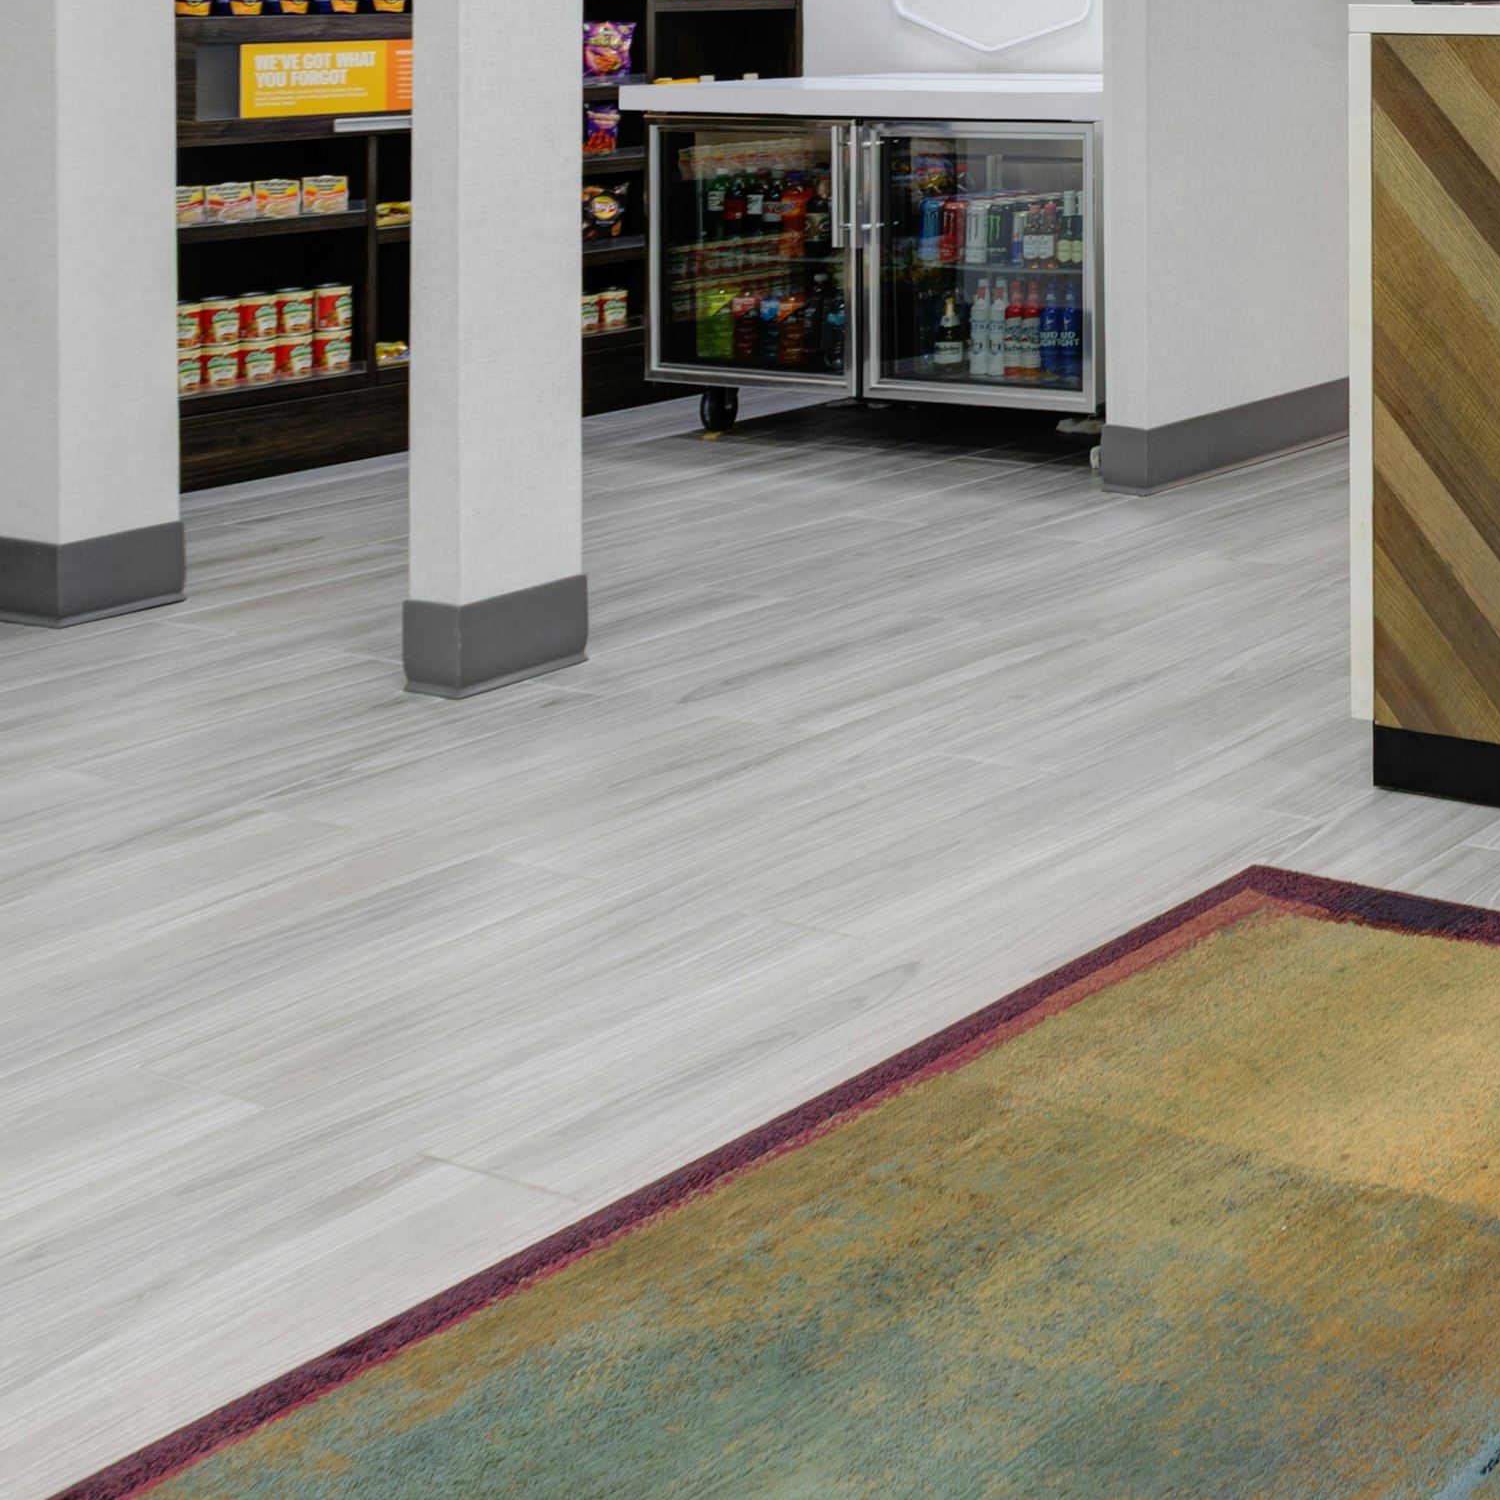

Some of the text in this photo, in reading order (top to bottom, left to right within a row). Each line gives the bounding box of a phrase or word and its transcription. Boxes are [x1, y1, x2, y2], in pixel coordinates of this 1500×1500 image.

[254, 51, 377, 71] WE'VE GOT WHAT
[254, 69, 348, 88] YOU FORGOT
